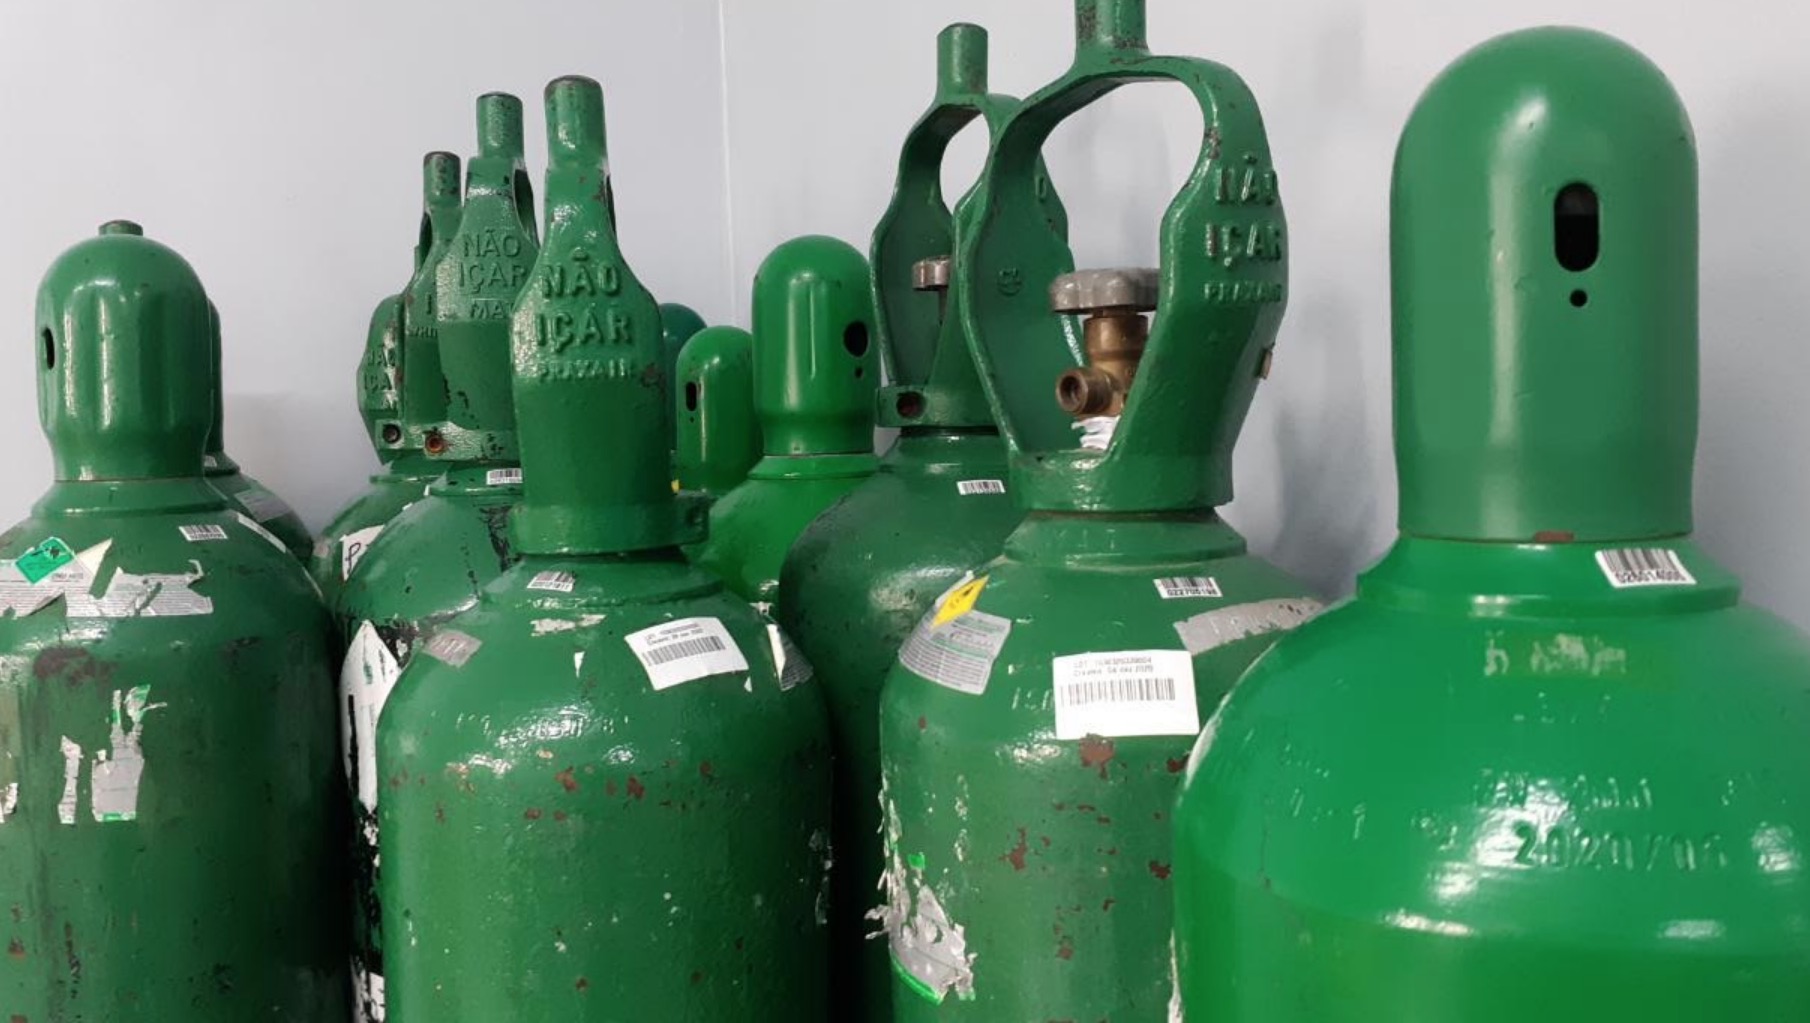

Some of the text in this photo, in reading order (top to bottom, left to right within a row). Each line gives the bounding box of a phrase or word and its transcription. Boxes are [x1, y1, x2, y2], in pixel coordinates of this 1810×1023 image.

[1215, 154, 1278, 206] NÃO
[463, 229, 521, 258] NÃO
[1206, 223, 1282, 267] IÇAR
[540, 247, 622, 298] NÃO
[536, 307, 633, 353] IÇAR
